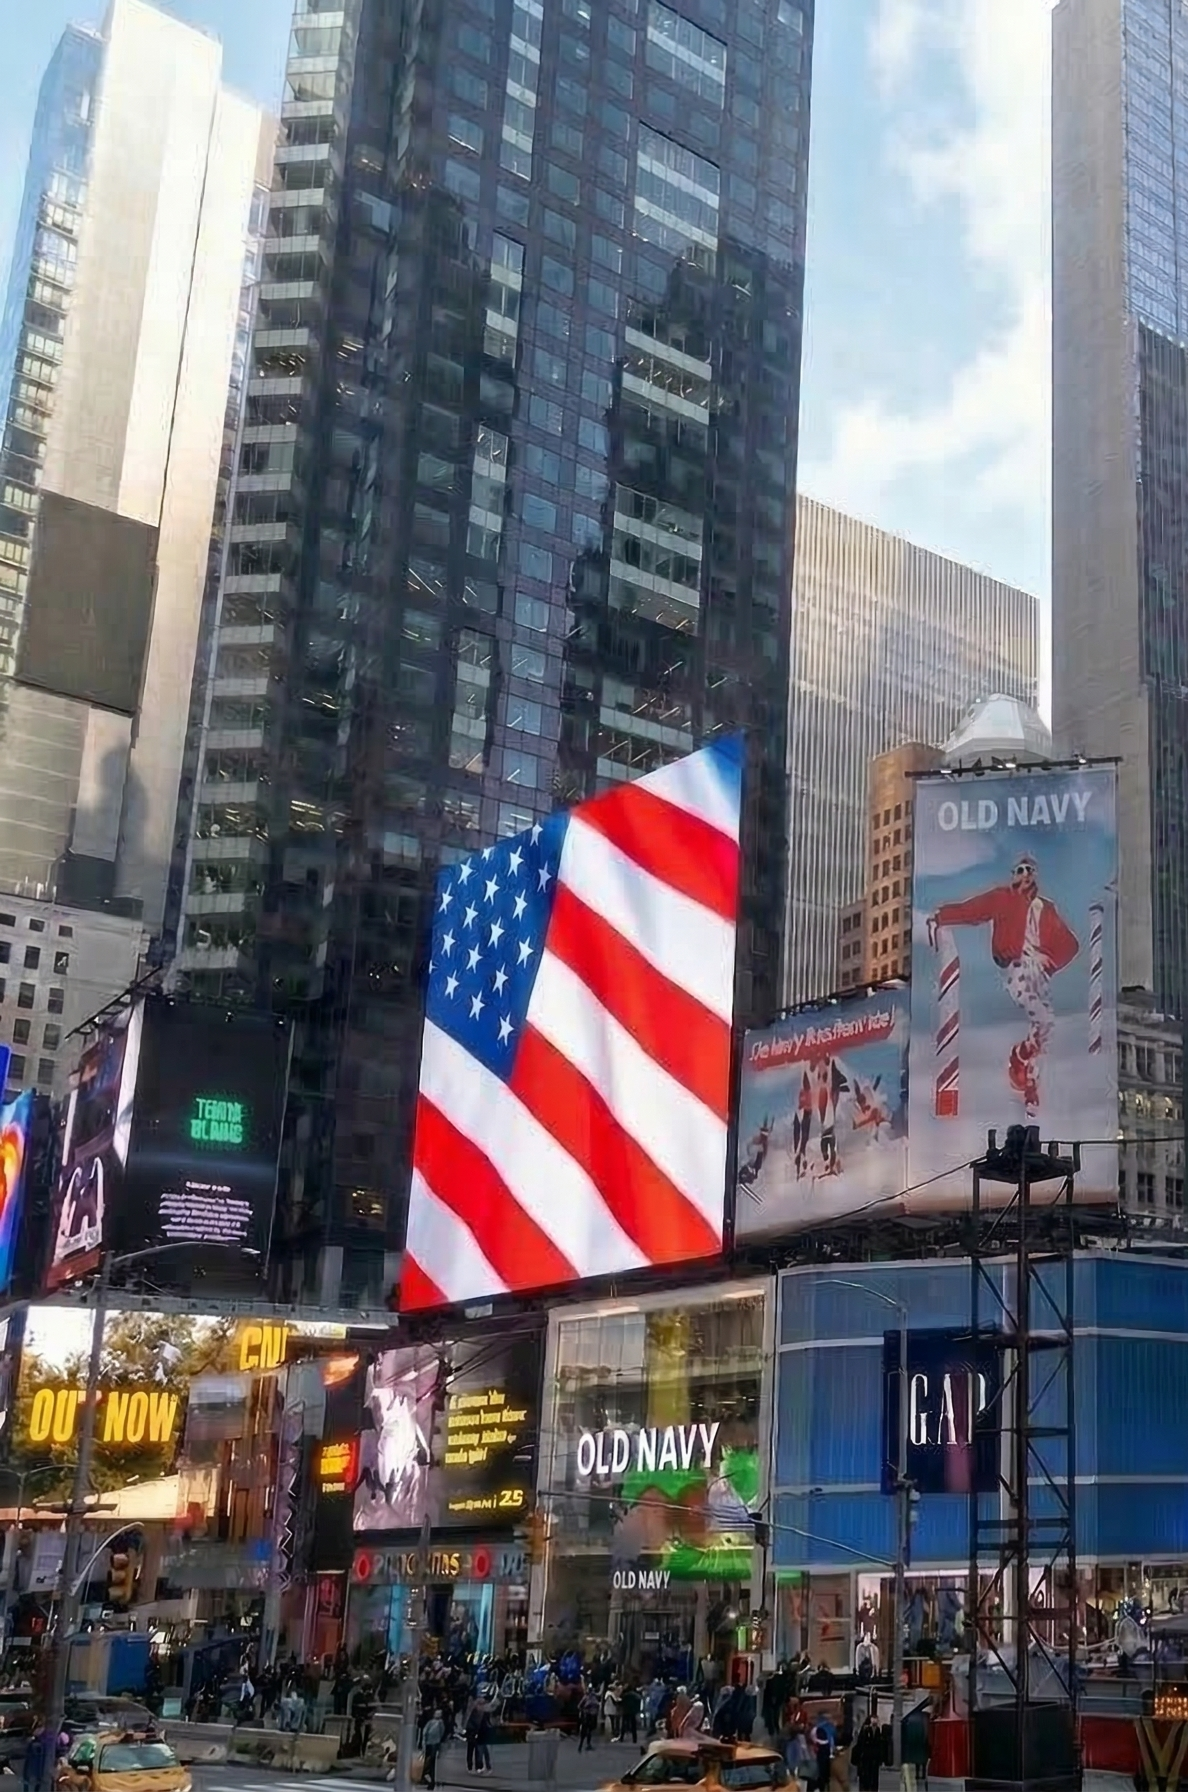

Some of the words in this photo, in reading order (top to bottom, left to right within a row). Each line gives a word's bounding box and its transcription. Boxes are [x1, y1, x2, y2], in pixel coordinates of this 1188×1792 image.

[937, 800, 999, 832] OLD
[1007, 791, 1093, 827] NAVY
[103, 1391, 178, 1443] NOW
[577, 1429, 631, 1476] OLD
[637, 1422, 721, 1473] NAVY
[613, 1570, 636, 1589] OLD
[638, 1570, 671, 1589] NAVY
